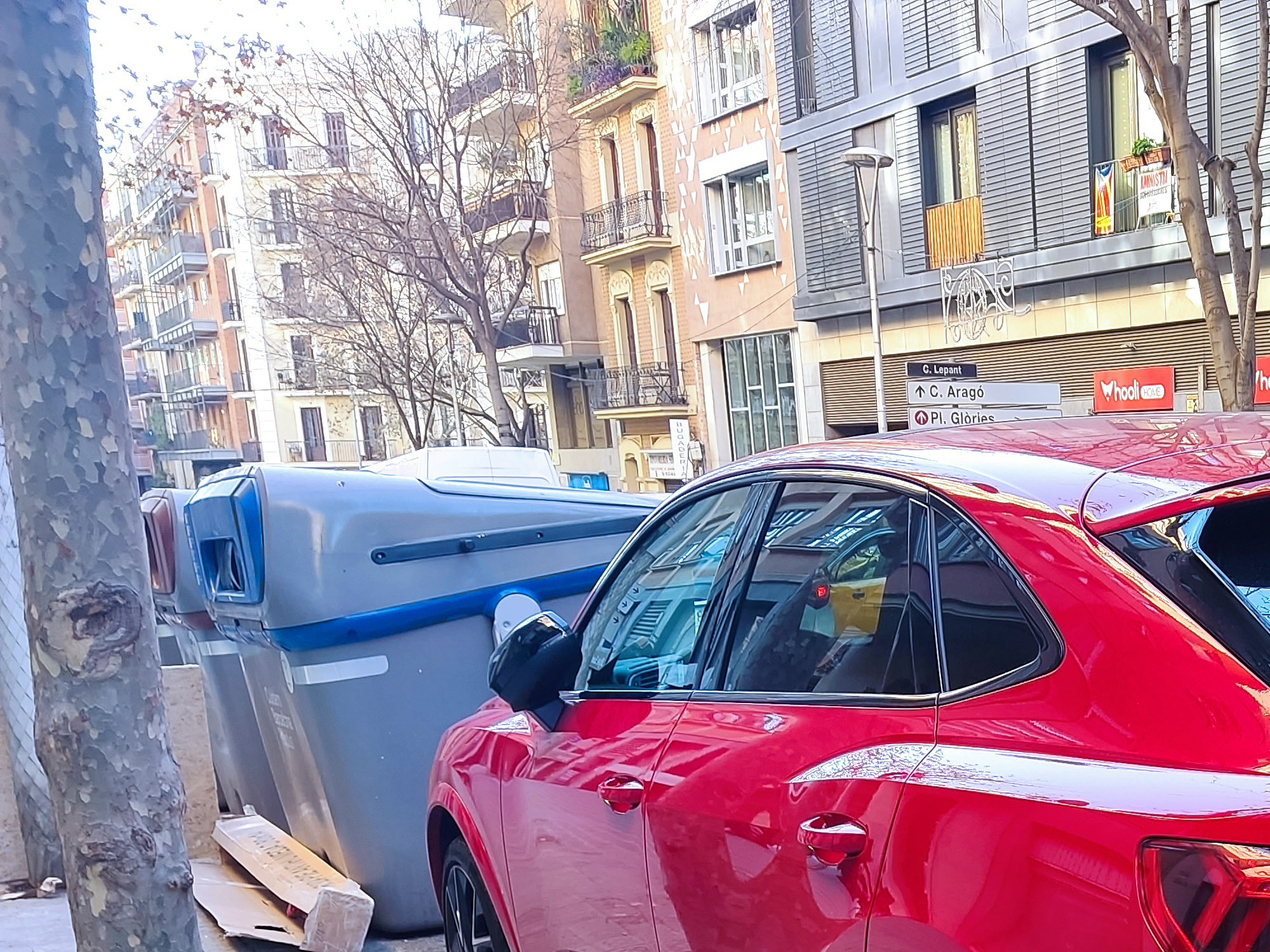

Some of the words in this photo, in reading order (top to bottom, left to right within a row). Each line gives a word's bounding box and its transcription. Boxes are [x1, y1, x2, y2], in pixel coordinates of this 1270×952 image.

[922, 364, 932, 375] C.
[933, 364, 963, 377] Lepant
[929, 385, 943, 398] C.
[947, 384, 985, 401] Aragó
[1143, 386, 1162, 397] HOME
[930, 411, 947, 425] Pl.
[950, 411, 995, 425] Glòries
